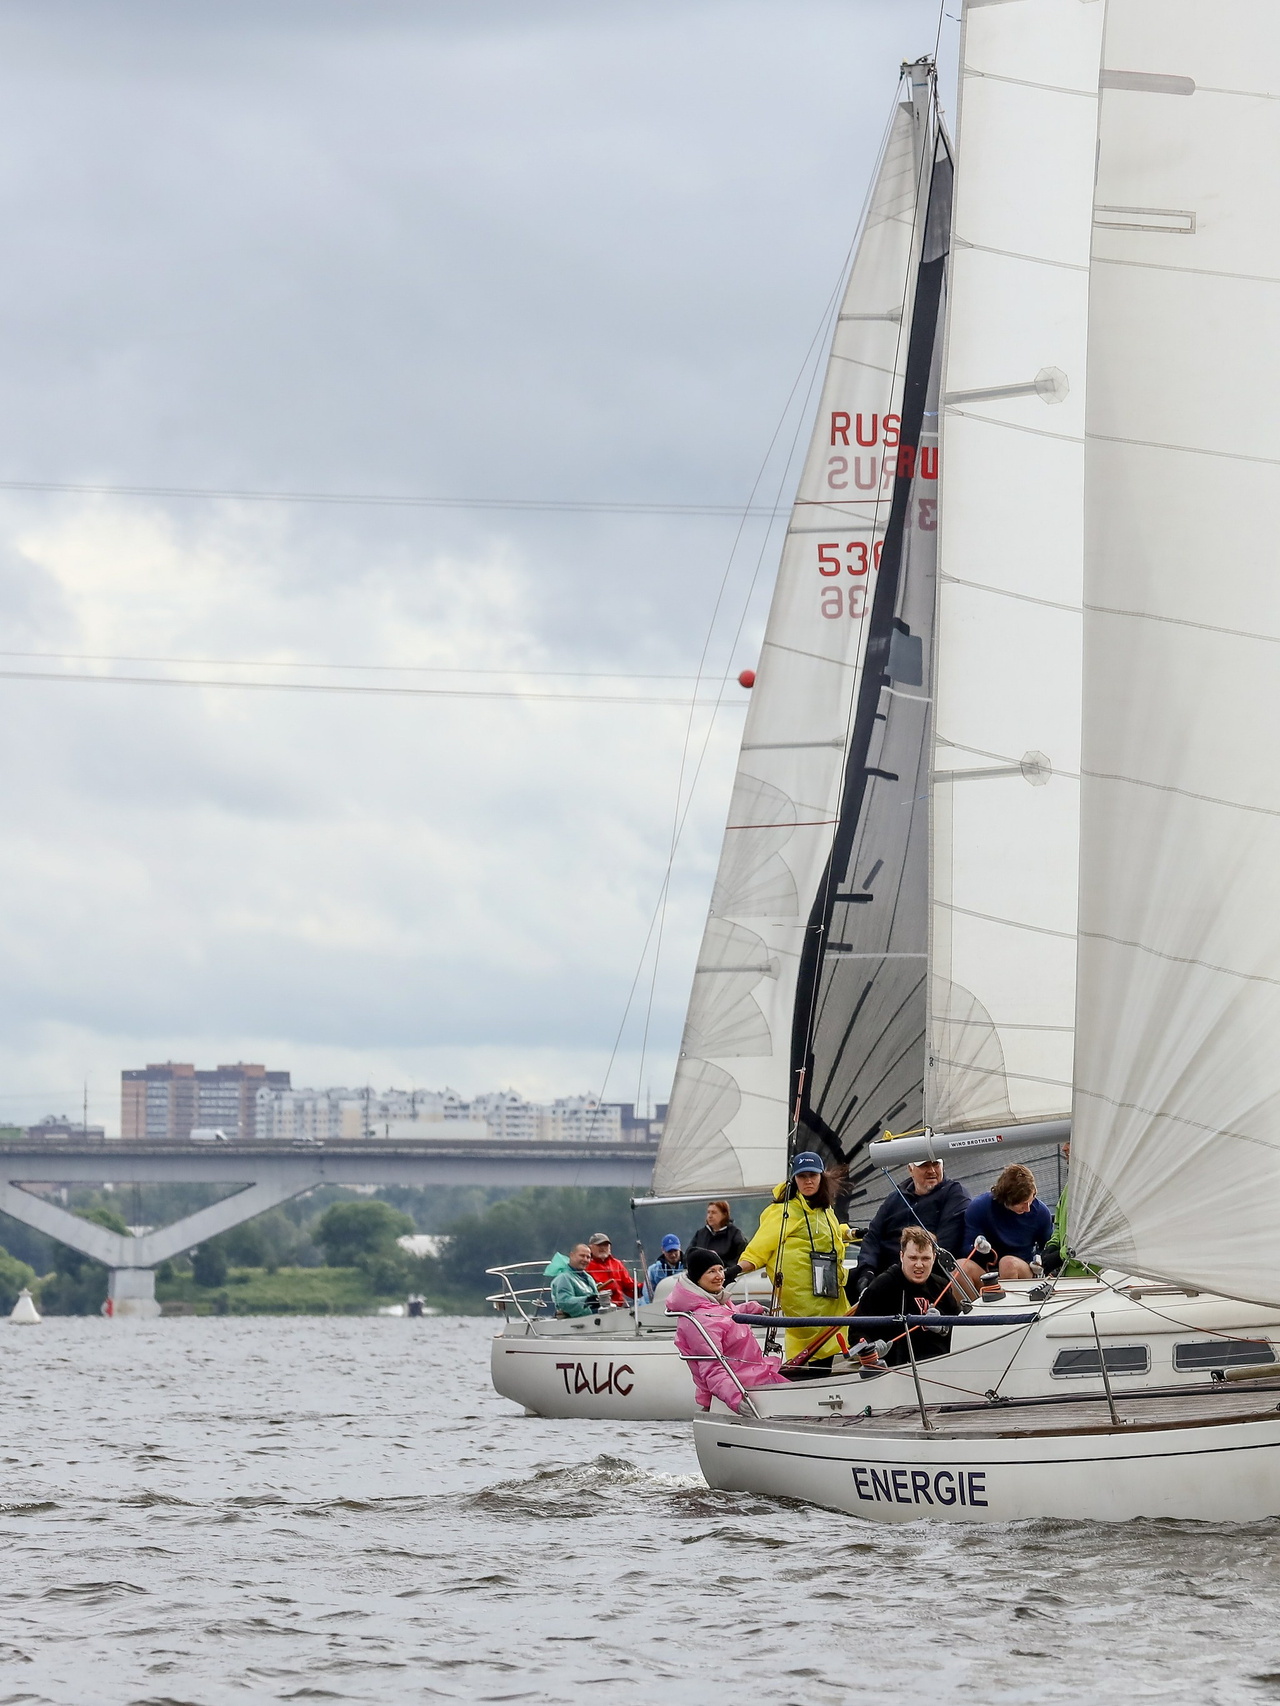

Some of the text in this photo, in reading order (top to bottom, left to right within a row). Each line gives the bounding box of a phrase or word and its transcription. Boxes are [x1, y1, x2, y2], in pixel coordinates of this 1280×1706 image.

[830, 412, 901, 447] RUS
[967, 1137, 995, 1145] BROTHERS
[851, 1467, 989, 1507] ENERGIE
